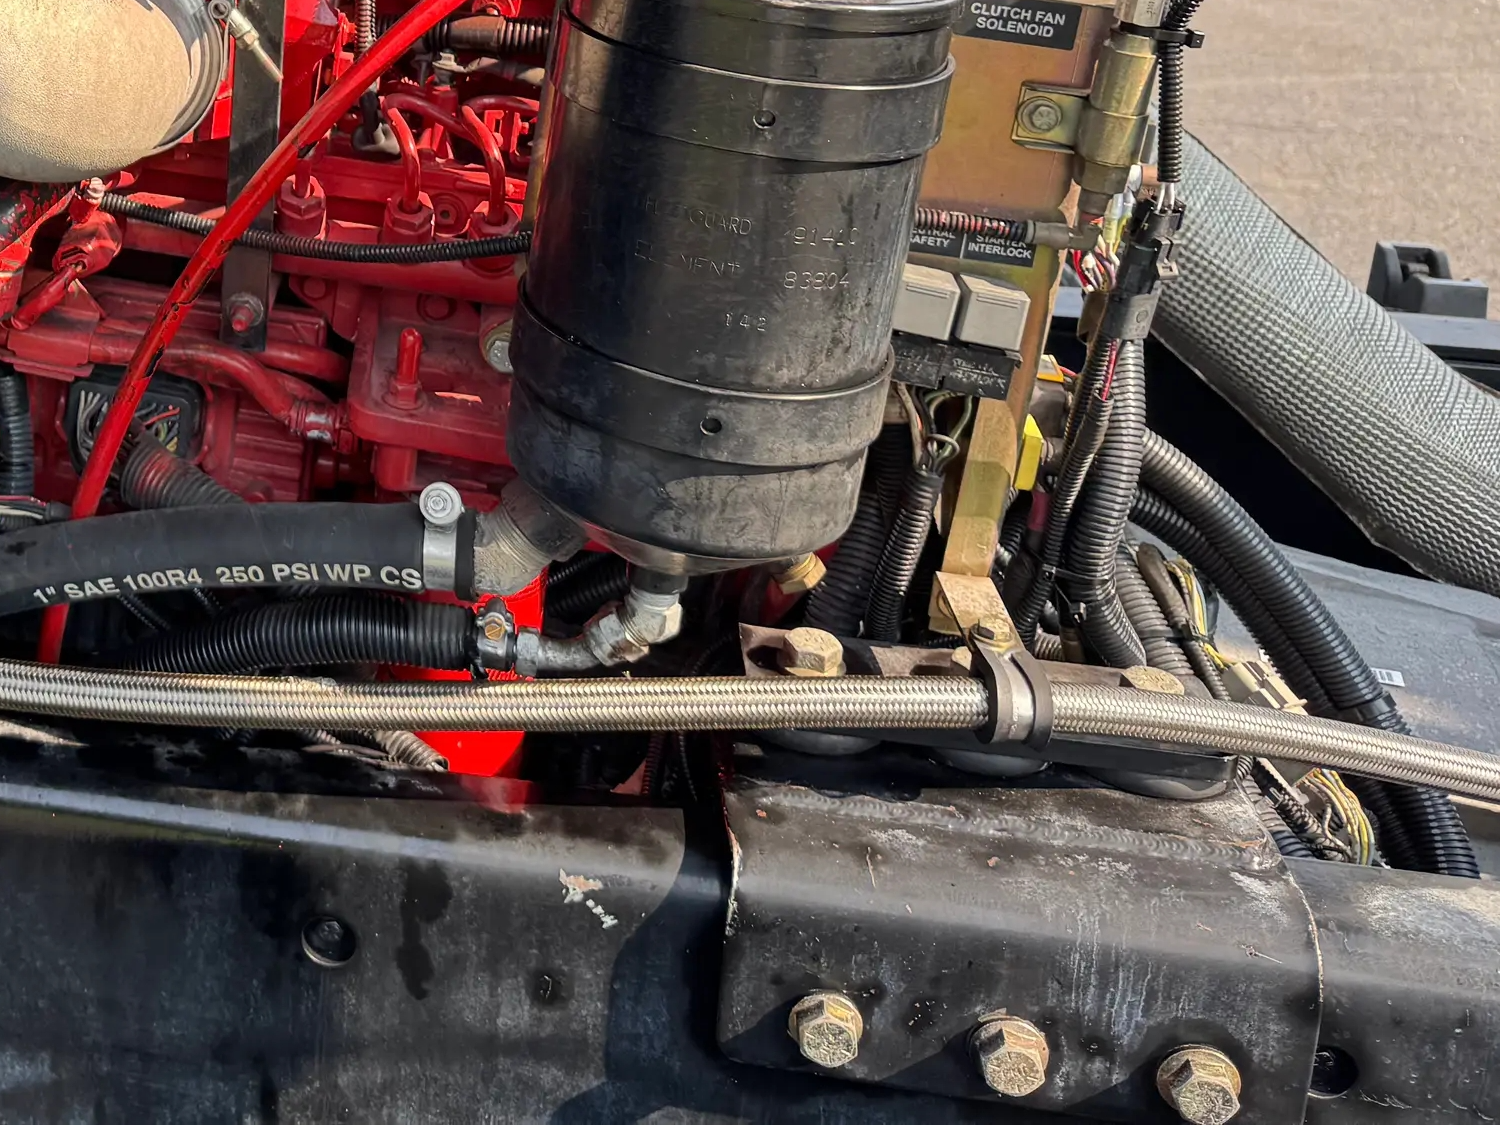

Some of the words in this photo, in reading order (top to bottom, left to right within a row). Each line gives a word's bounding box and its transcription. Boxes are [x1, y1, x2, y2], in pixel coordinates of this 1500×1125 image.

[970, 2, 1032, 21] CLUTCH
[1035, 11, 1066, 26] FAN
[976, 16, 1054, 37] SOLENOID
[967, 242, 1032, 260] INTERLOCK
[63, 577, 120, 599] SAE
[123, 567, 203, 592] 100R4
[215, 566, 264, 583] 250
[271, 562, 319, 582] PSI
[324, 563, 372, 582] WP
